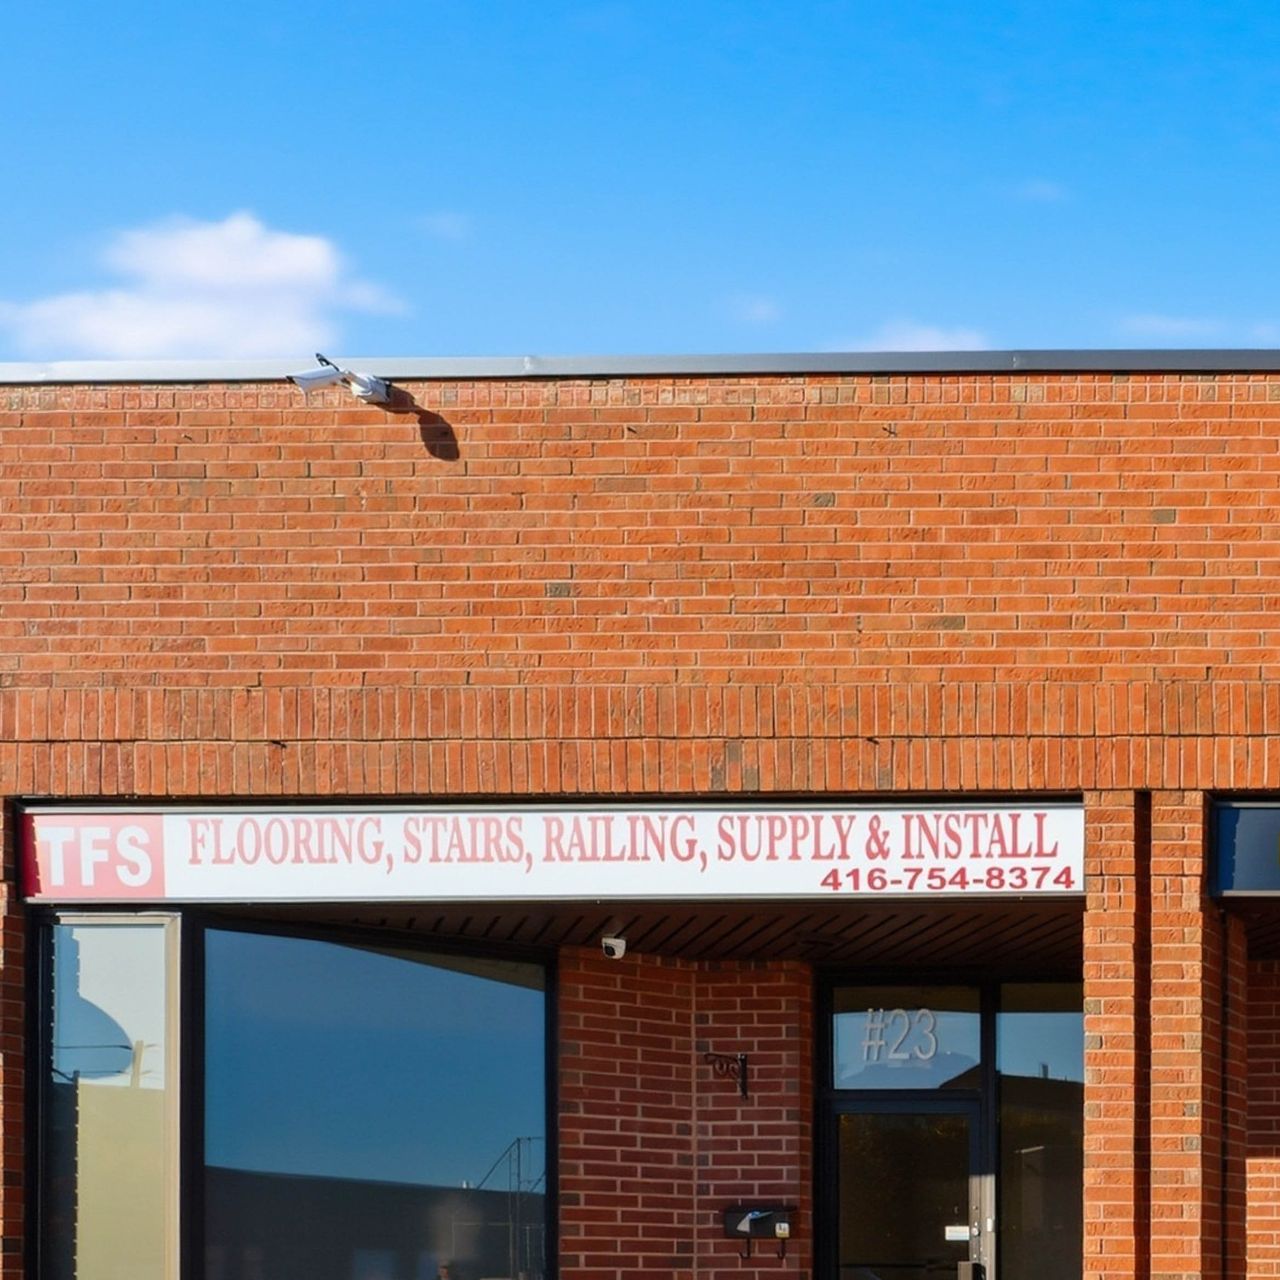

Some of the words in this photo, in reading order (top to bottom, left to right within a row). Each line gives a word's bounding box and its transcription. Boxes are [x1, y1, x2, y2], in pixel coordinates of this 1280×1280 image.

[39, 826, 153, 887] TFS
[187, 817, 394, 875] FLOORING,
[403, 817, 534, 874] STAIRS,
[542, 815, 708, 872] RAILING,
[717, 815, 856, 861] SUPPLY
[865, 815, 890, 860] &
[900, 813, 1058, 859] INSTALL
[820, 866, 1076, 891] 416-754-8374
[861, 1008, 938, 1060] #23
